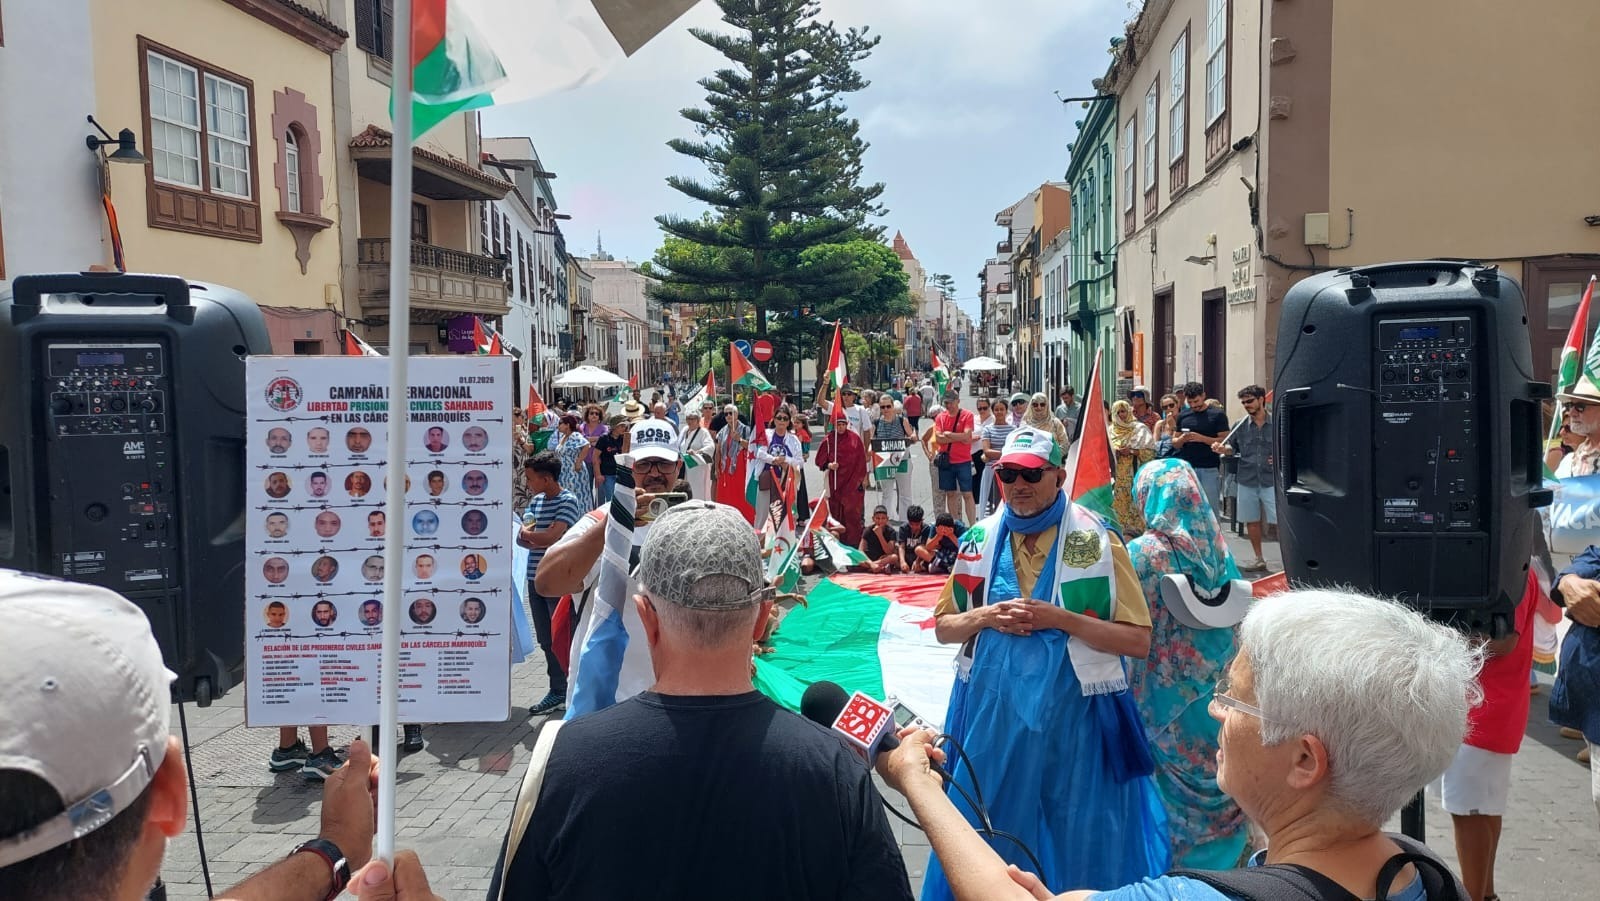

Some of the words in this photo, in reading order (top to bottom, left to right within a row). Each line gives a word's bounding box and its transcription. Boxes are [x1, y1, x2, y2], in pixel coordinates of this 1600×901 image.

[329, 384, 384, 400] CAMPAÑA
[386, 385, 472, 399] IRNACIONAL
[307, 401, 348, 411] LIBERTAD
[350, 401, 408, 411] PRISION
[410, 401, 442, 411] CIVILES
[444, 400, 494, 411] SAHARAUIS
[331, 413, 342, 423] EN
[344, 413, 361, 423] LAS
[363, 411, 408, 423] CÁRC
[410, 411, 471, 423] MARROQUÍES
[636, 428, 671, 440] BOSS
[881, 440, 906, 451] SAHARA
[422, 640, 450, 648] CÁRCELES
